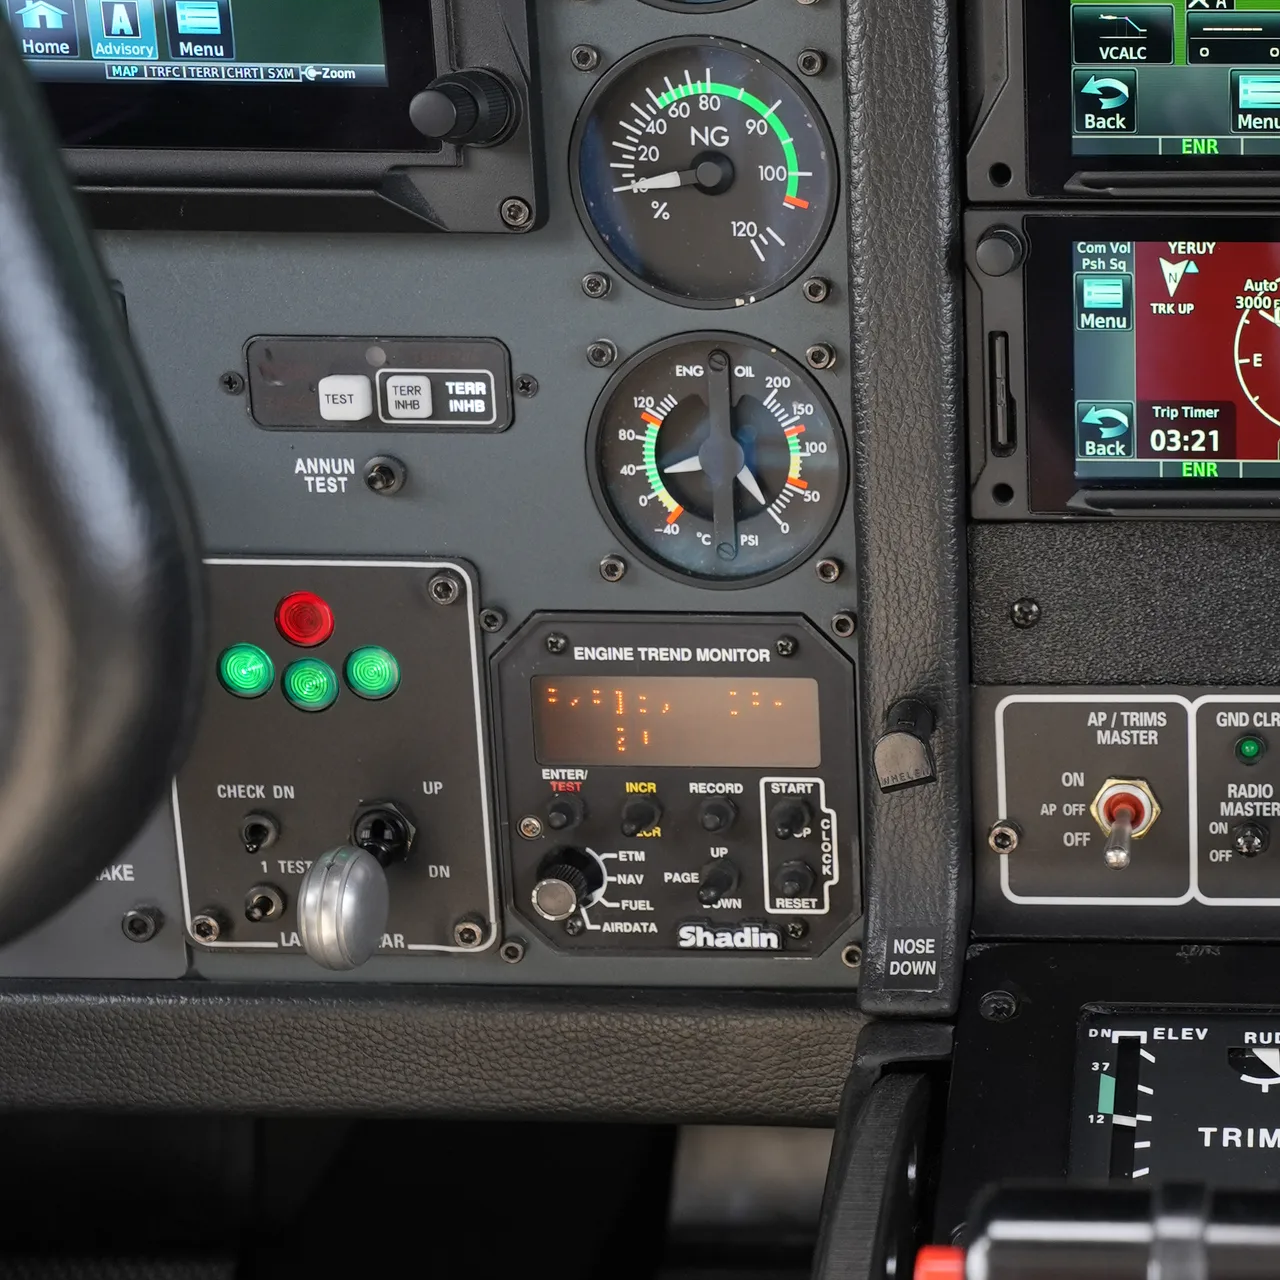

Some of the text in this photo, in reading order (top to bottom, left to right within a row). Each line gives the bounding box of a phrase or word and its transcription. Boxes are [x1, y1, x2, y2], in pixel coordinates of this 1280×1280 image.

[23, 40, 69, 54] Home
[96, 43, 154, 57] Advisory
[180, 43, 223, 57] Menu
[1099, 47, 1146, 60] VCALC
[322, 68, 355, 79] Zoom
[746, 120, 767, 135] 90
[1085, 114, 1126, 129] Back
[691, 126, 729, 146] NG
[1168, 242, 1216, 254] YERUY
[1081, 314, 1126, 328] Menu
[676, 366, 704, 377] ENG
[734, 366, 755, 377] OIL
[445, 382, 486, 395] TERR
[449, 400, 485, 412] INHB
[1152, 407, 1219, 419] Trip Timer
[1150, 430, 1219, 452] 03:21
[295, 458, 355, 474] ANNUN
[305, 477, 348, 492] TEST
[574, 647, 770, 663] ENGINE TREND MONITOR
[1216, 713, 1280, 727] GND CLR
[1097, 731, 1158, 744] MASTER
[689, 783, 743, 794] RECORD
[771, 784, 813, 793] START
[1228, 784, 1273, 798] RADIO
[1220, 802, 1280, 816] MASTER
[776, 899, 817, 909] RESET
[602, 922, 657, 933] AIRDATA
[679, 926, 779, 948] Shadin
[893, 939, 935, 954] NOSE
[890, 961, 936, 976] DOWN
[1153, 1028, 1208, 1040] ELEV
